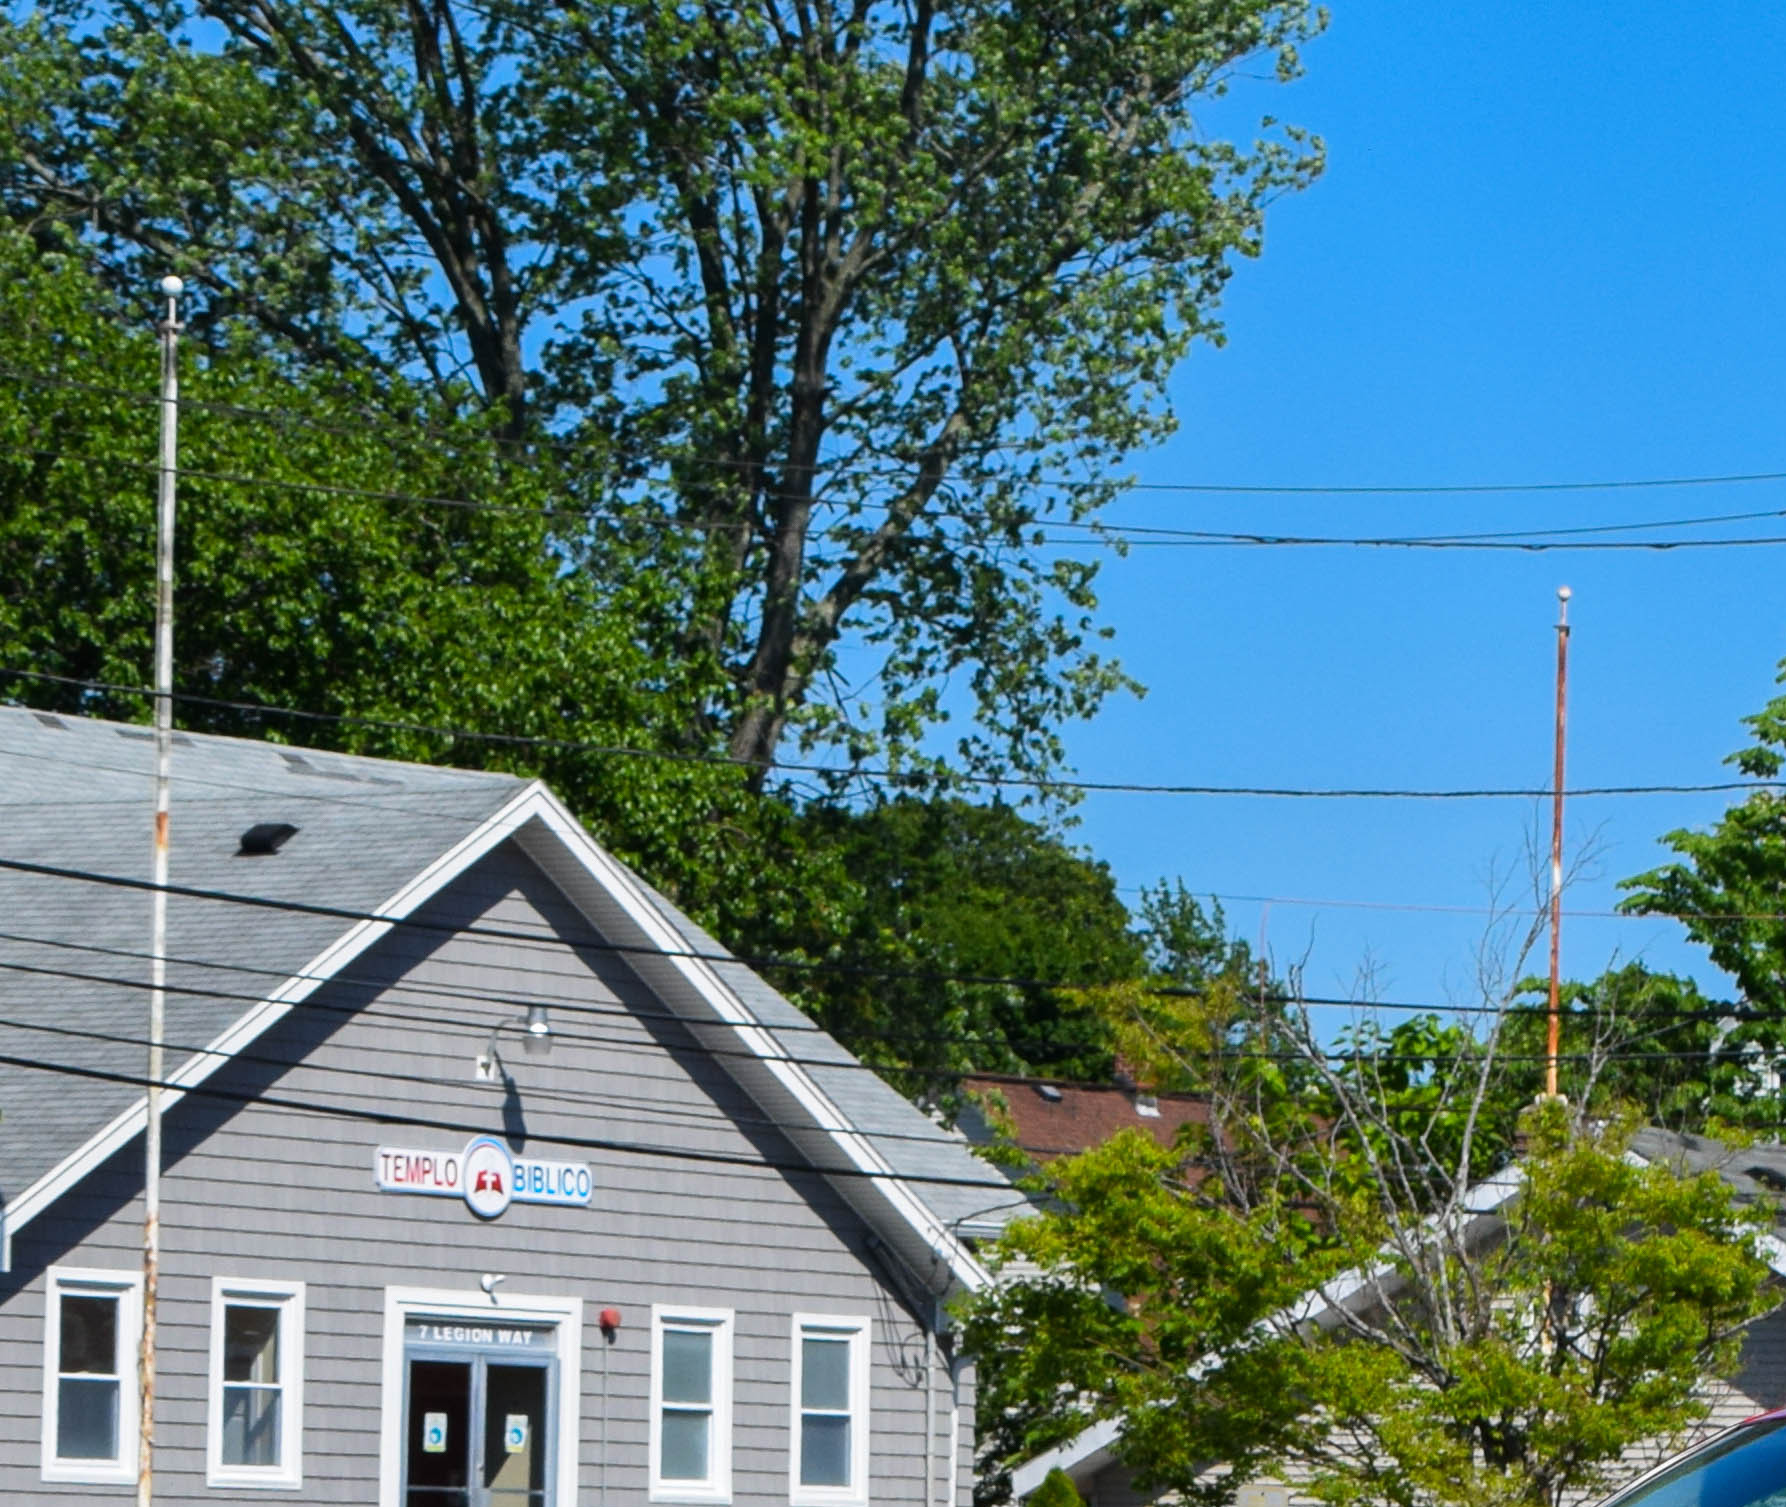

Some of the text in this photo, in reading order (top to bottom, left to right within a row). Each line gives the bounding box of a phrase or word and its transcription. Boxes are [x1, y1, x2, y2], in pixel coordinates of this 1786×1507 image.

[381, 1154, 590, 1197] TEMPLO BIBLICO
[420, 1325, 533, 1344] 7 LEGION WAY
